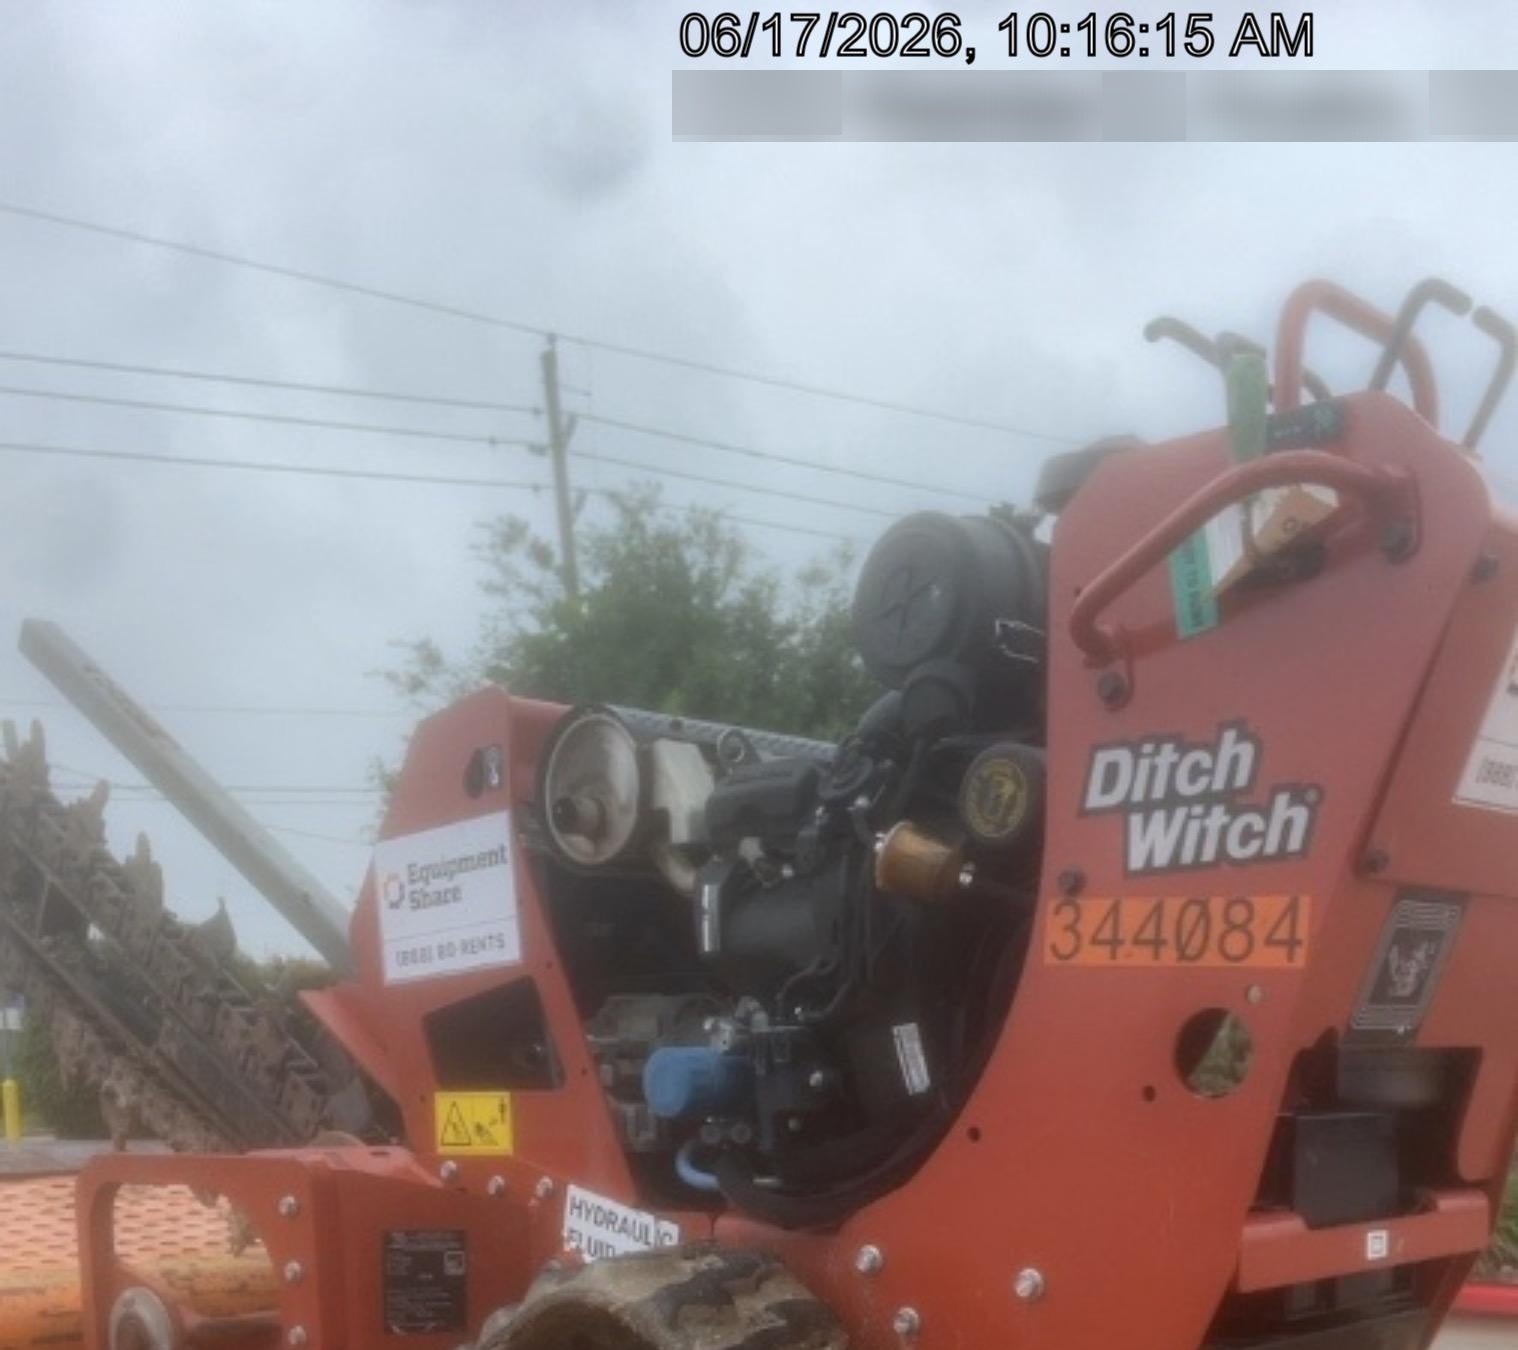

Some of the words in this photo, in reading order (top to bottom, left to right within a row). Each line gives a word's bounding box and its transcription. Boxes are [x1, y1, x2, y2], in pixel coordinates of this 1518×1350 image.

[1083, 726, 1257, 811] Ditch
[1127, 791, 1311, 872] Witch
[407, 843, 508, 886] Equipment
[409, 885, 463, 912] Share
[1050, 899, 1303, 963] 344084
[569, 1196, 674, 1246] HYDRAULIC
